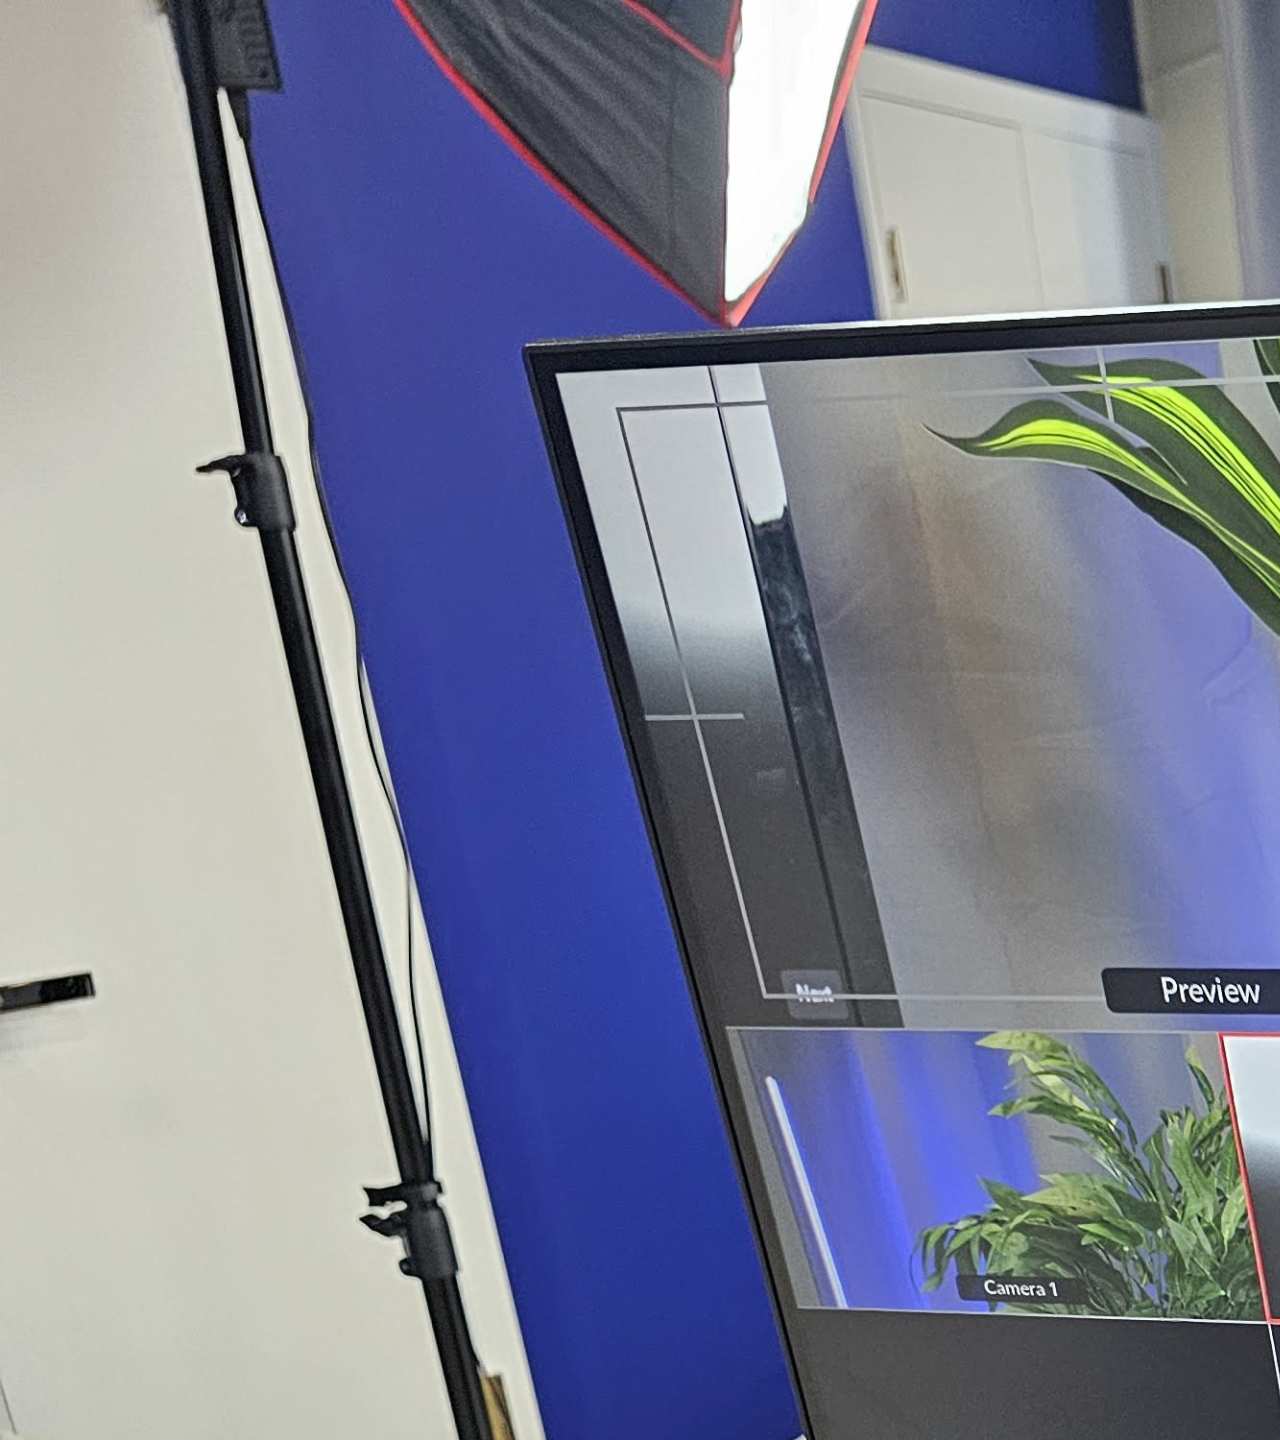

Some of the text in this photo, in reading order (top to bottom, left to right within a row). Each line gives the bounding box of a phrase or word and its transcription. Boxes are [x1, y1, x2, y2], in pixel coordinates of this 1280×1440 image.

[1161, 978, 1260, 1006] Preview
[984, 1280, 1058, 1298] Camera 1
